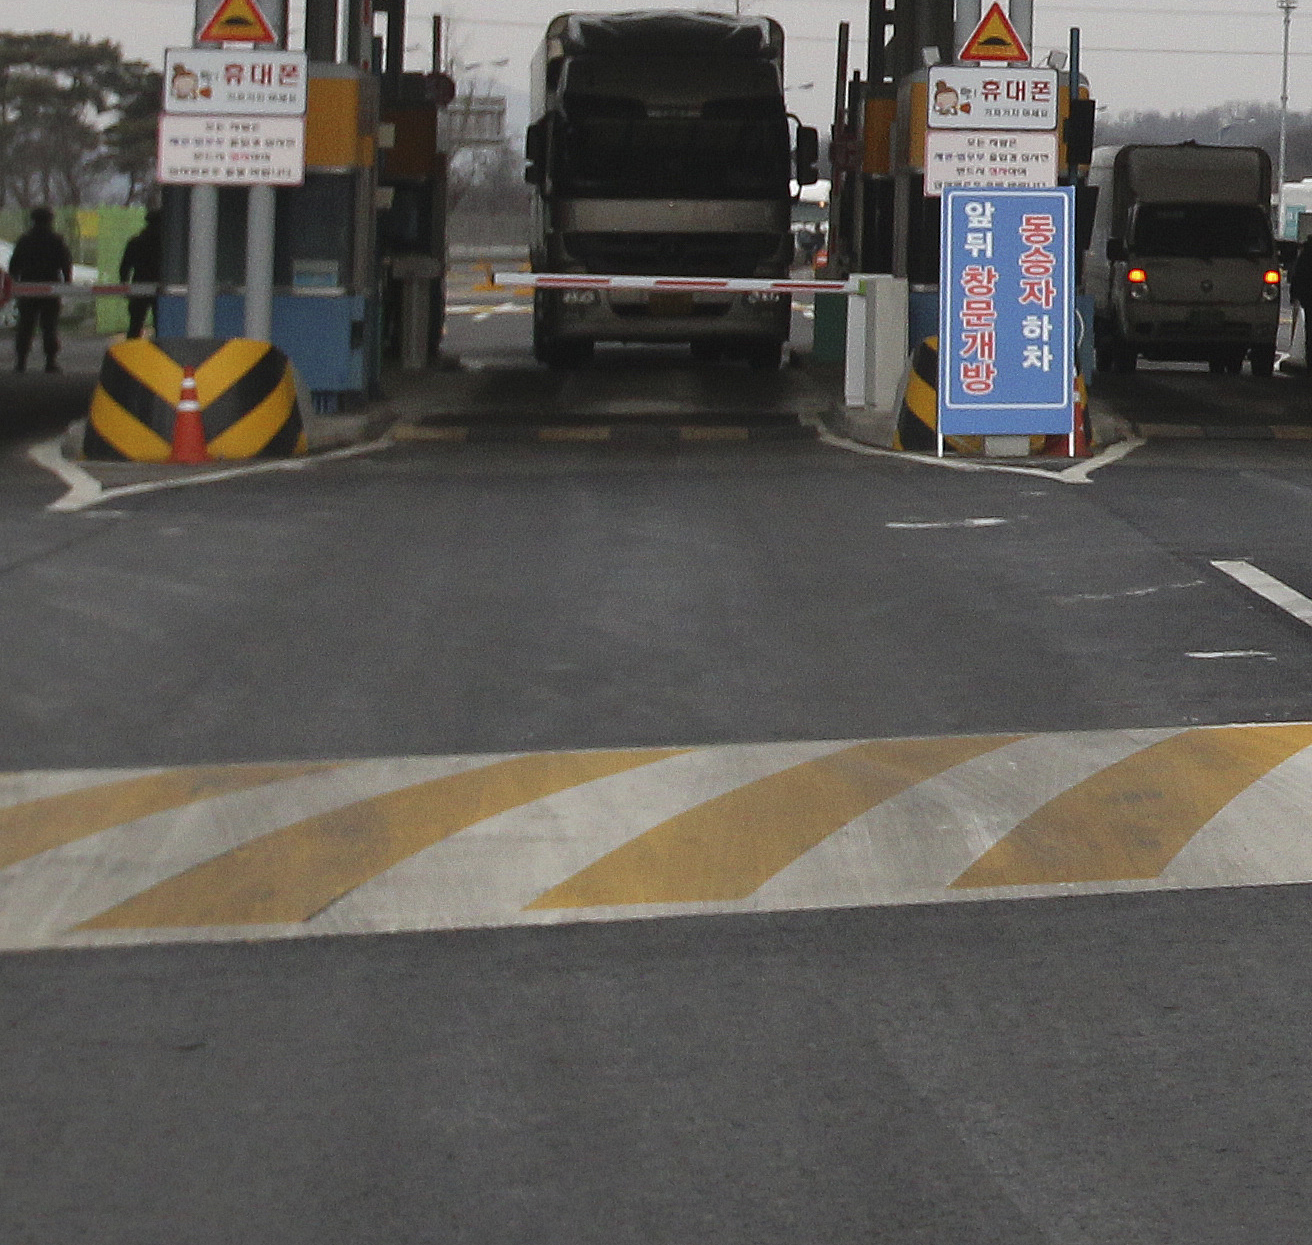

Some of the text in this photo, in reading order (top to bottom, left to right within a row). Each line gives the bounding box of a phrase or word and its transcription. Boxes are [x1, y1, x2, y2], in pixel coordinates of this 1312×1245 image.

[224, 64, 299, 87] 휴대폰
[981, 79, 1051, 103] 휴대폰
[963, 201, 996, 258] 앞뒤
[1018, 214, 1057, 373] 동승자 하차
[959, 265, 999, 395] 창문개방
